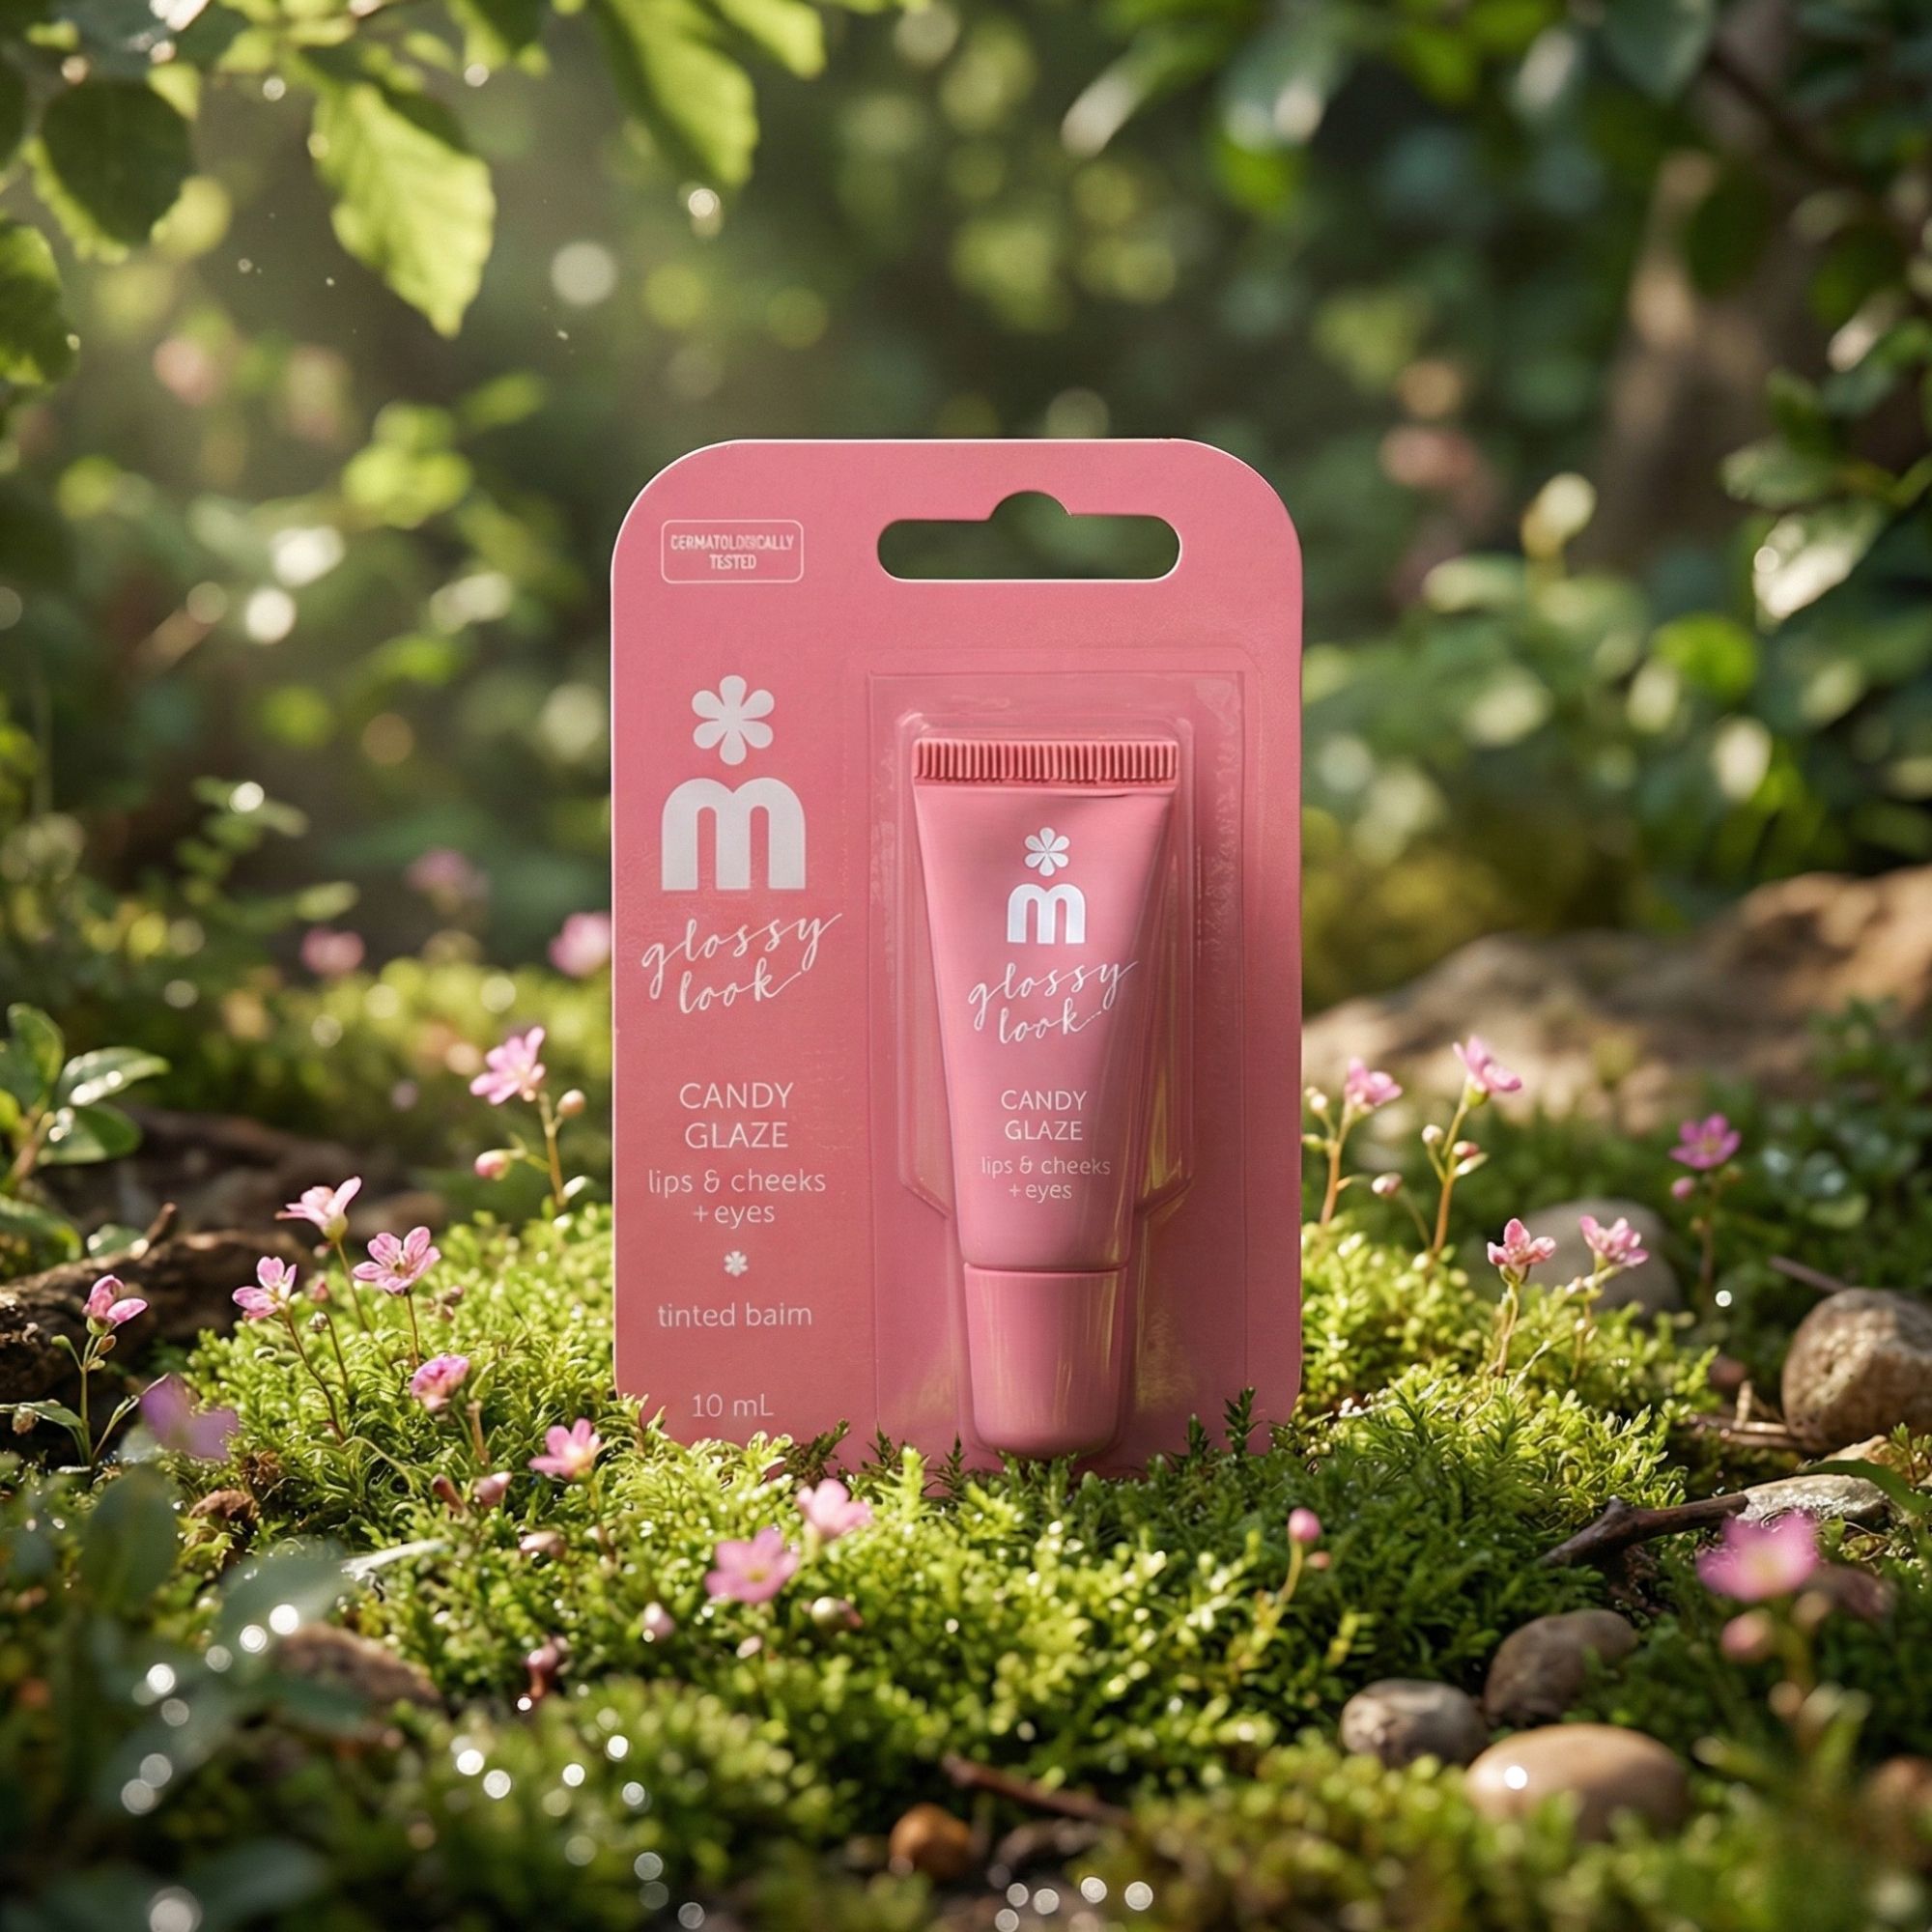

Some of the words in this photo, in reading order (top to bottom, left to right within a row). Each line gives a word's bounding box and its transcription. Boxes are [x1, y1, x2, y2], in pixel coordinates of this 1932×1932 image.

[709, 554, 757, 570] TESTED
[661, 778, 806, 891] m
[1007, 883, 1086, 945] m
[641, 913, 842, 1000] glossy
[679, 957, 802, 1013] look
[968, 960, 1139, 1031] glossy
[999, 998, 1102, 1044] look
[679, 1082, 794, 1109] CANDY
[1001, 1090, 1088, 1111] CANDY
[685, 1122, 788, 1149] GLAZE
[1005, 1121, 1083, 1141] GLAZE
[981, 1156, 1013, 1176] lips
[1040, 1156, 1111, 1175] cheeks
[648, 1169, 693, 1198] lips
[703, 1170, 720, 1193] &
[730, 1169, 826, 1193] cheeks
[658, 1303, 736, 1328] tinted
[692, 1394, 723, 1417] 10
[733, 1394, 775, 1417] mL
